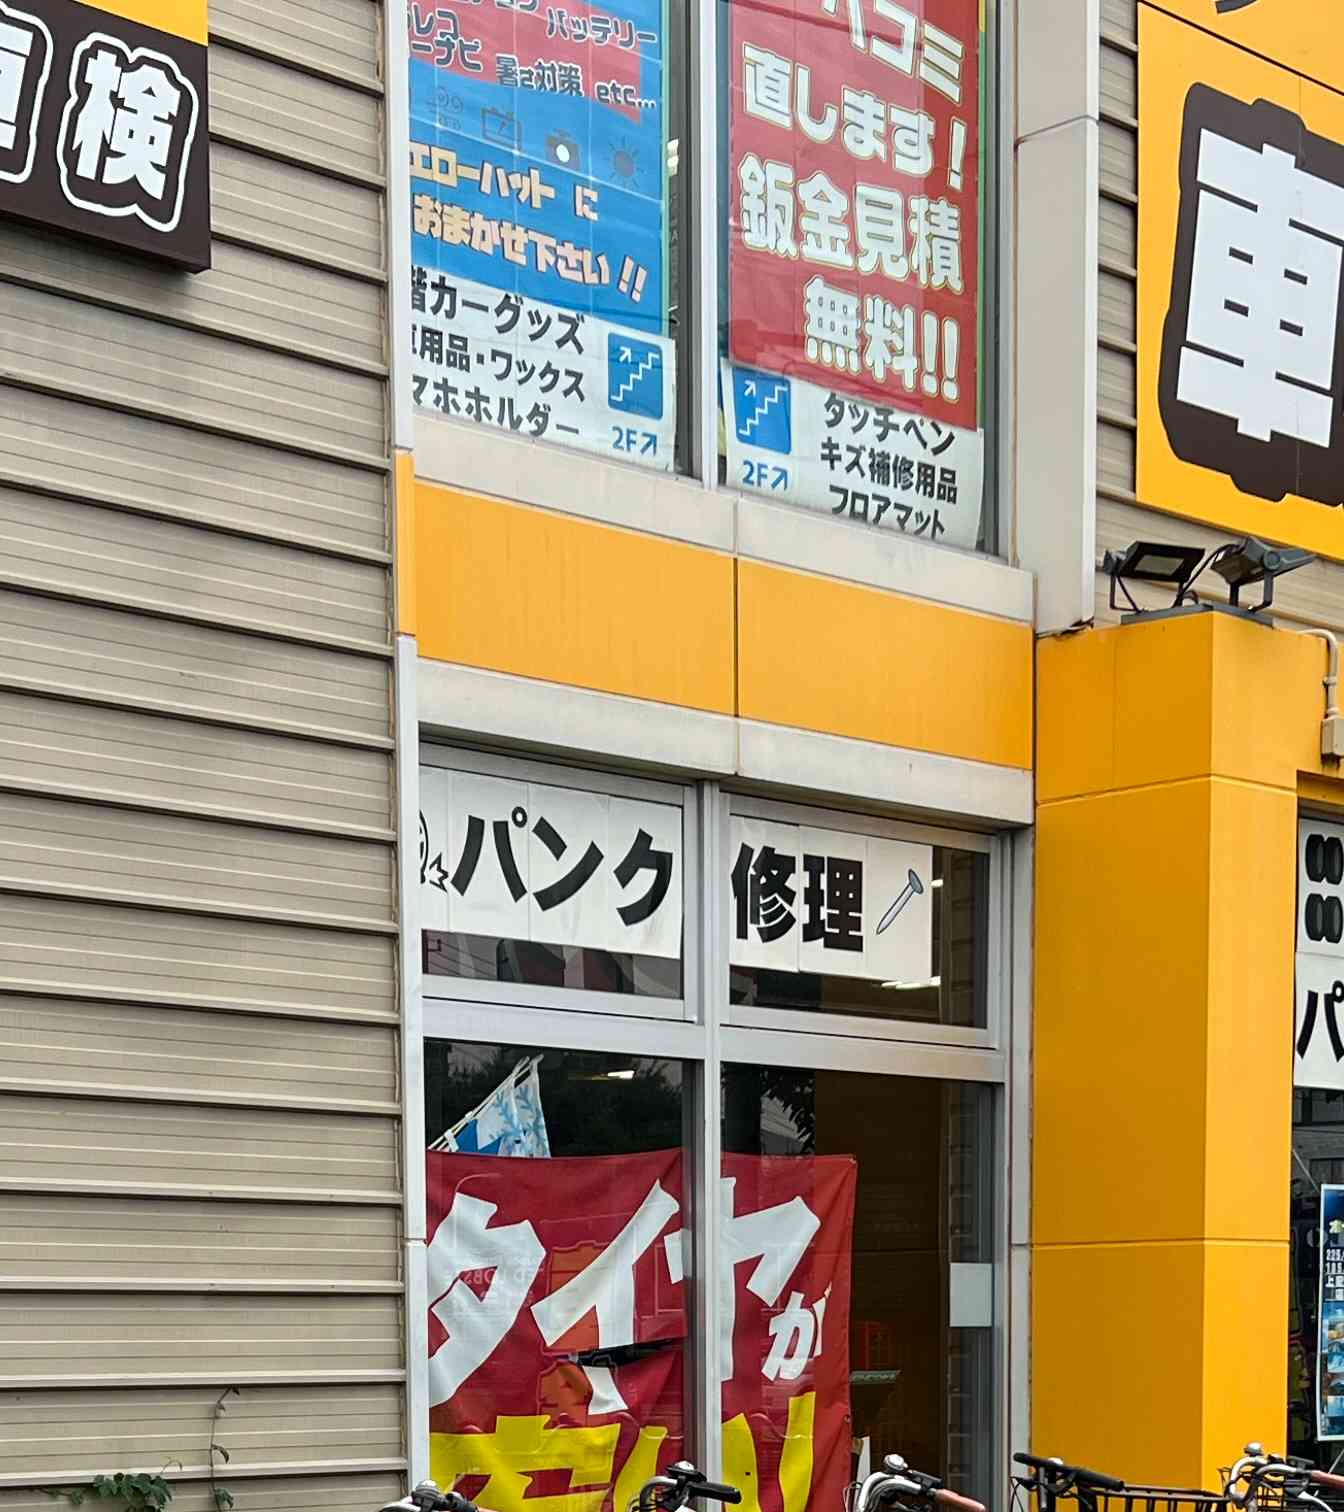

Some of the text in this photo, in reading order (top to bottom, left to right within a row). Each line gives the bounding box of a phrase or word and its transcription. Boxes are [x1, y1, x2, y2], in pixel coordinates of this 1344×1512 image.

[546, 7, 658, 49] バッテリー
[738, 152, 964, 293] 鈑金見積
[412, 324, 586, 402] 用品・ワックス
[823, 392, 955, 456] タッチペン
[820, 436, 957, 505] キズ補修用品
[828, 484, 945, 541] フロアマット
[451, 805, 864, 953] パンク 修理
